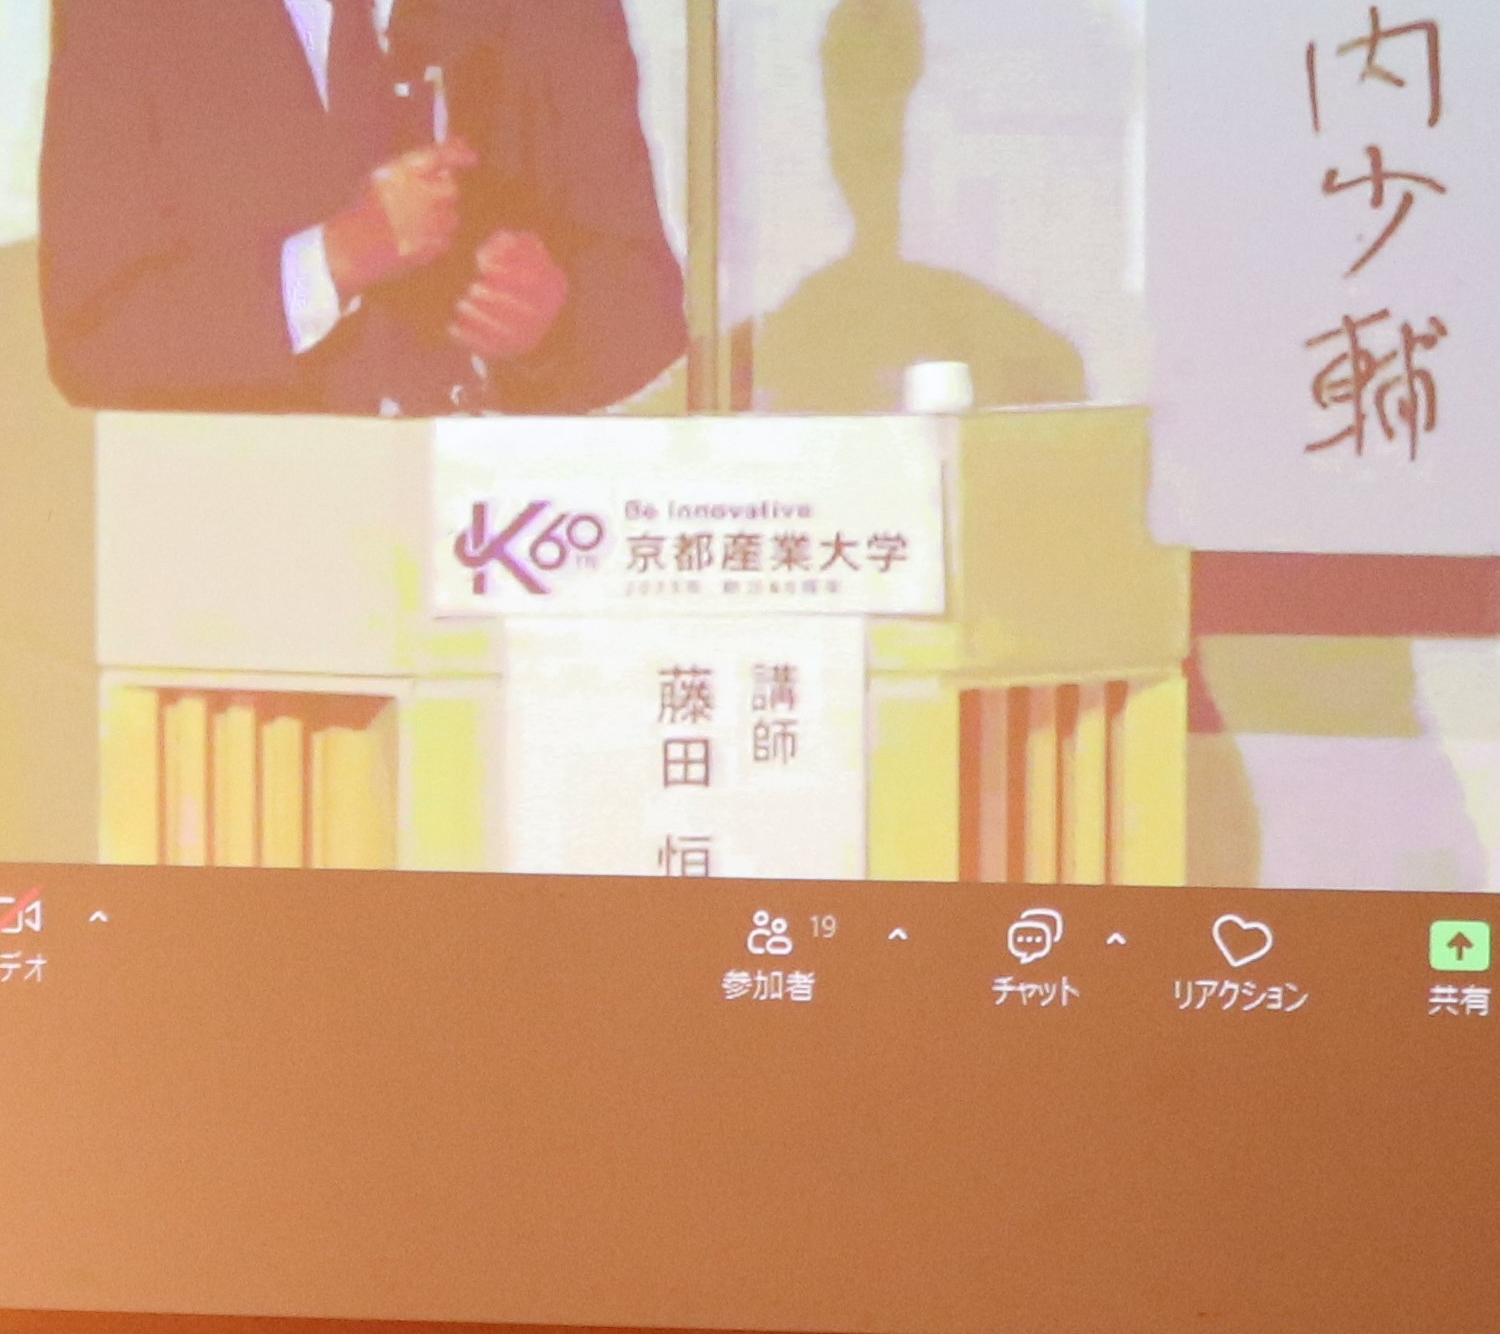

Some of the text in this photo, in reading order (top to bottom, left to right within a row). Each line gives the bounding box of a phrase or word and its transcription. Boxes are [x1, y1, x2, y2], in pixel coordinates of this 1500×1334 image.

[626, 529, 909, 573] 京都産業大学
[657, 666, 716, 789] 藤田
[752, 664, 798, 766] 講師
[809, 915, 836, 938] 19
[721, 970, 815, 1001] 参加者
[991, 976, 1079, 1006] チャット
[1174, 979, 1308, 1012] リアクション
[1428, 985, 1491, 1017] 共有
